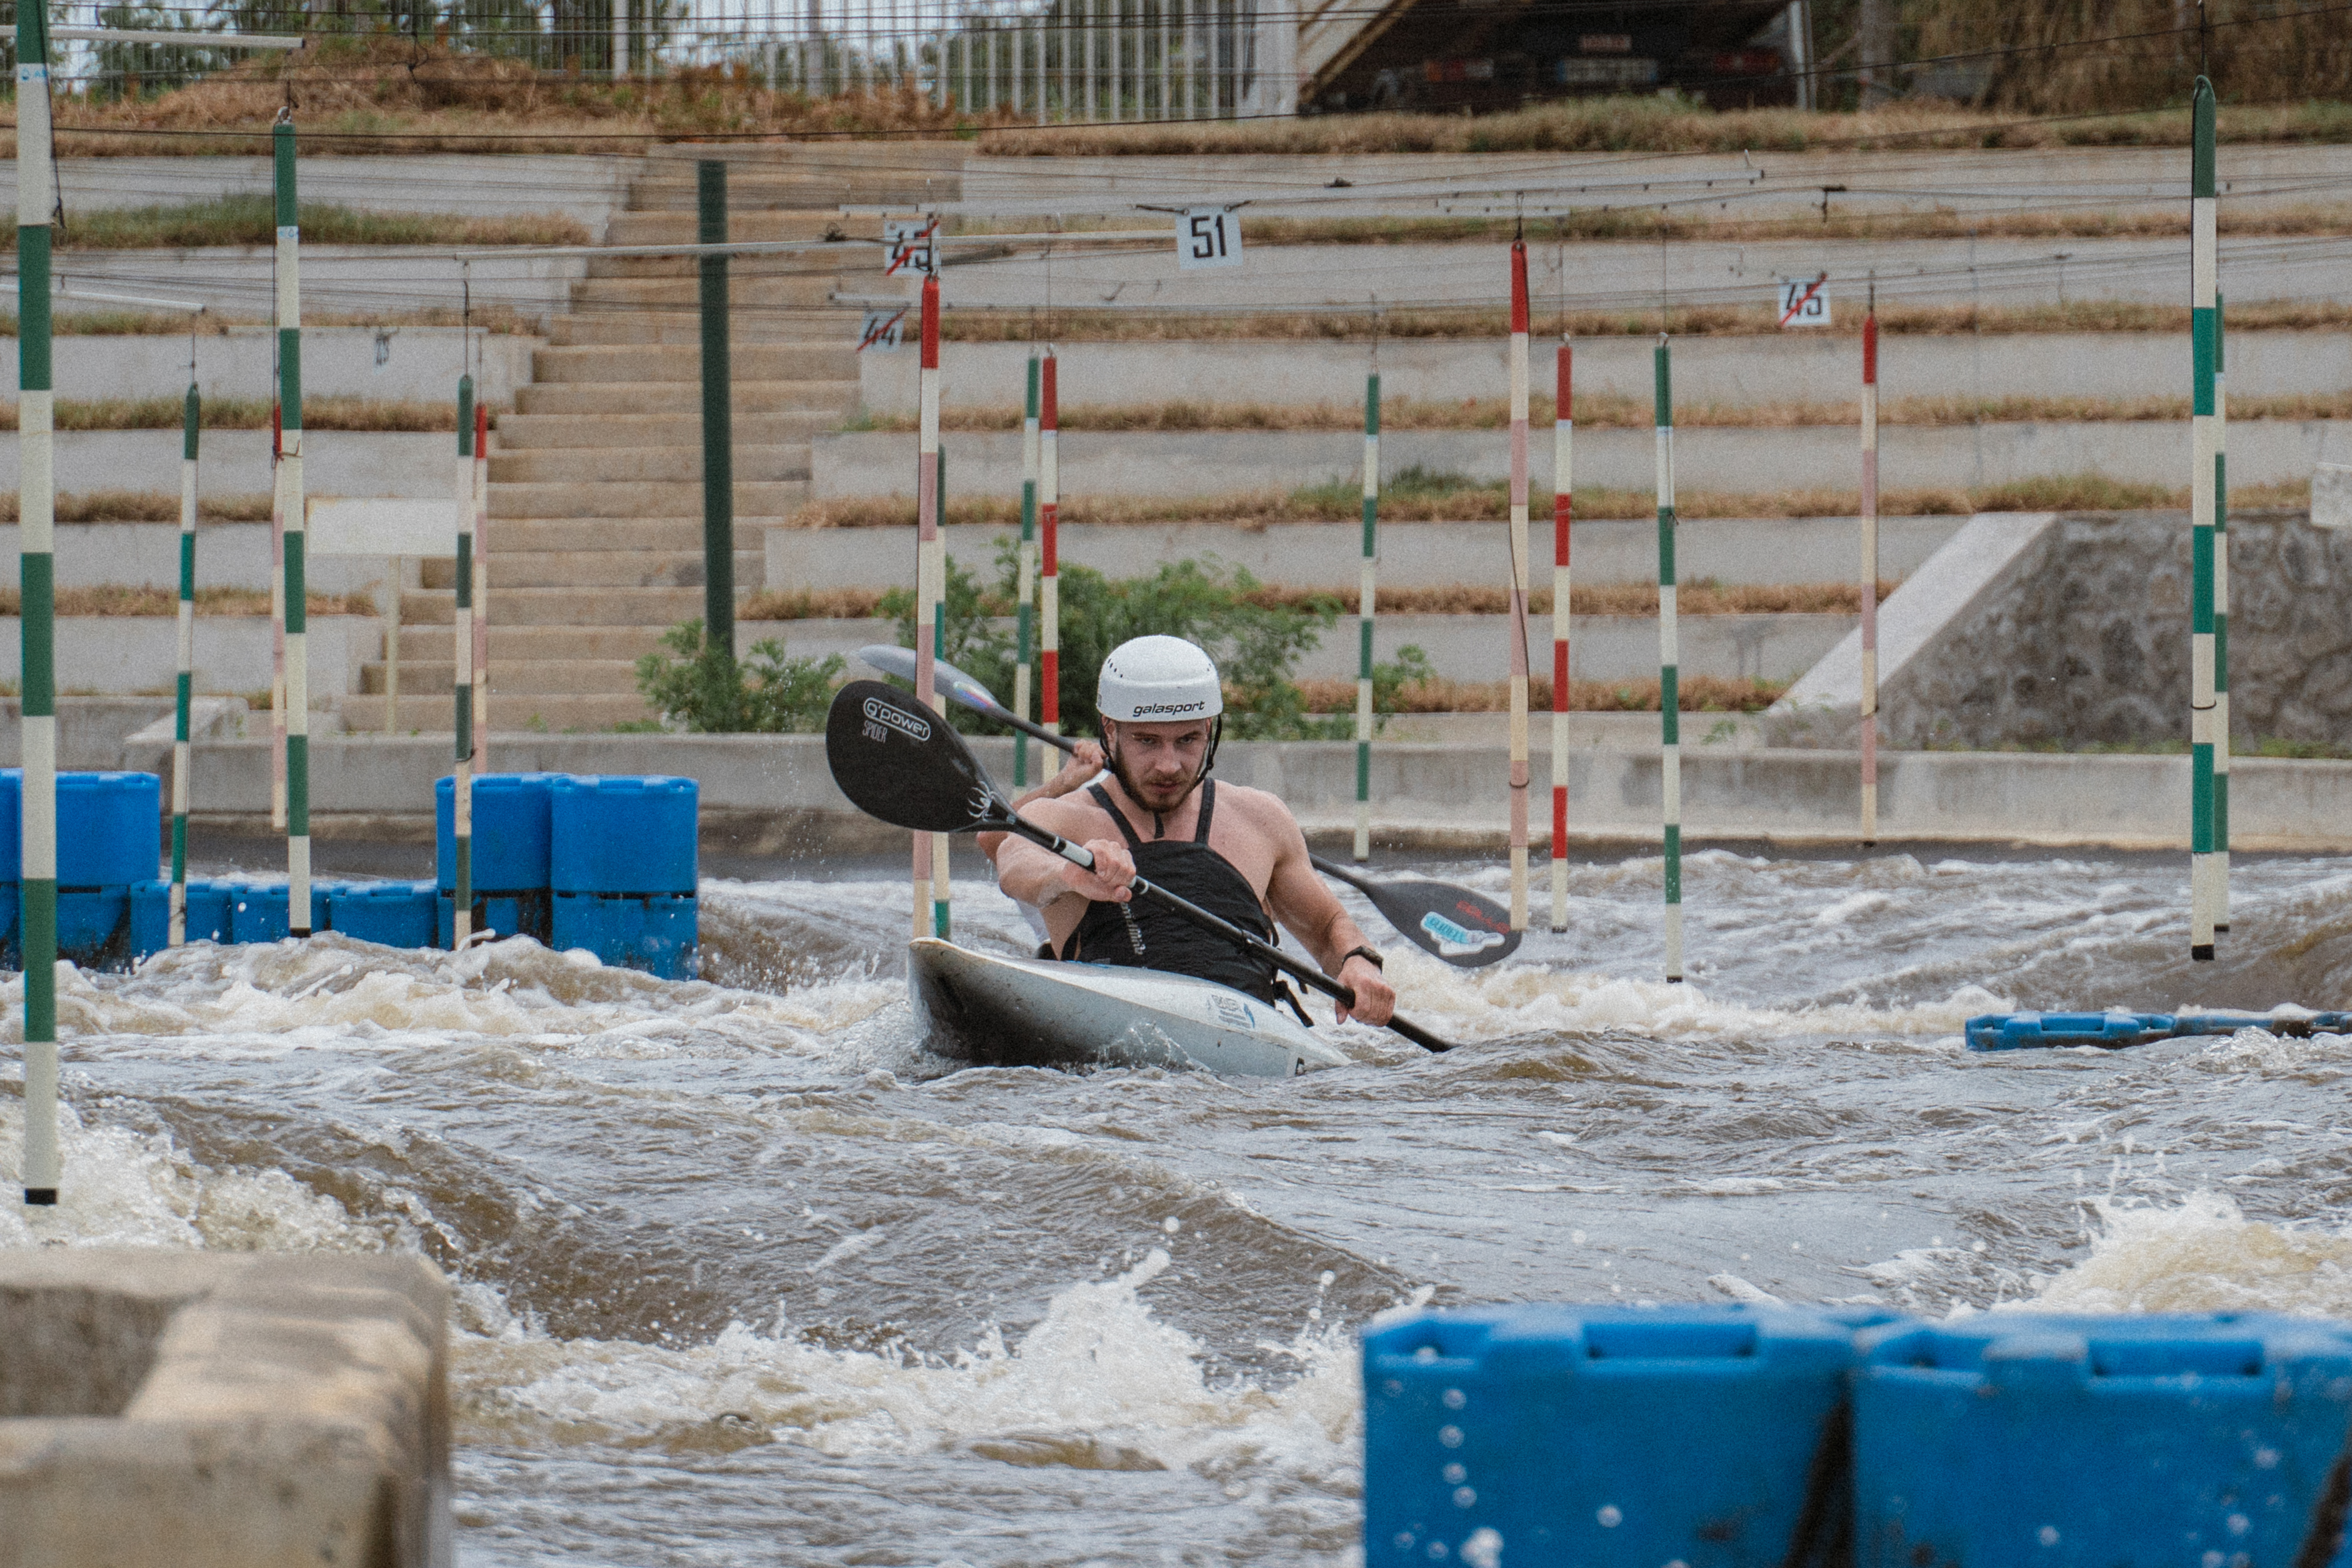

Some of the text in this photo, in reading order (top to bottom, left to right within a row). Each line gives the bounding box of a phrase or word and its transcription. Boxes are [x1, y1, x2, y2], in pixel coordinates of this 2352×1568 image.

[1191, 215, 1227, 259] 51
[1786, 284, 1822, 315] 45
[864, 316, 896, 346] 44
[1132, 701, 1206, 717] galasport
[862, 720, 888, 744] SPIDER
